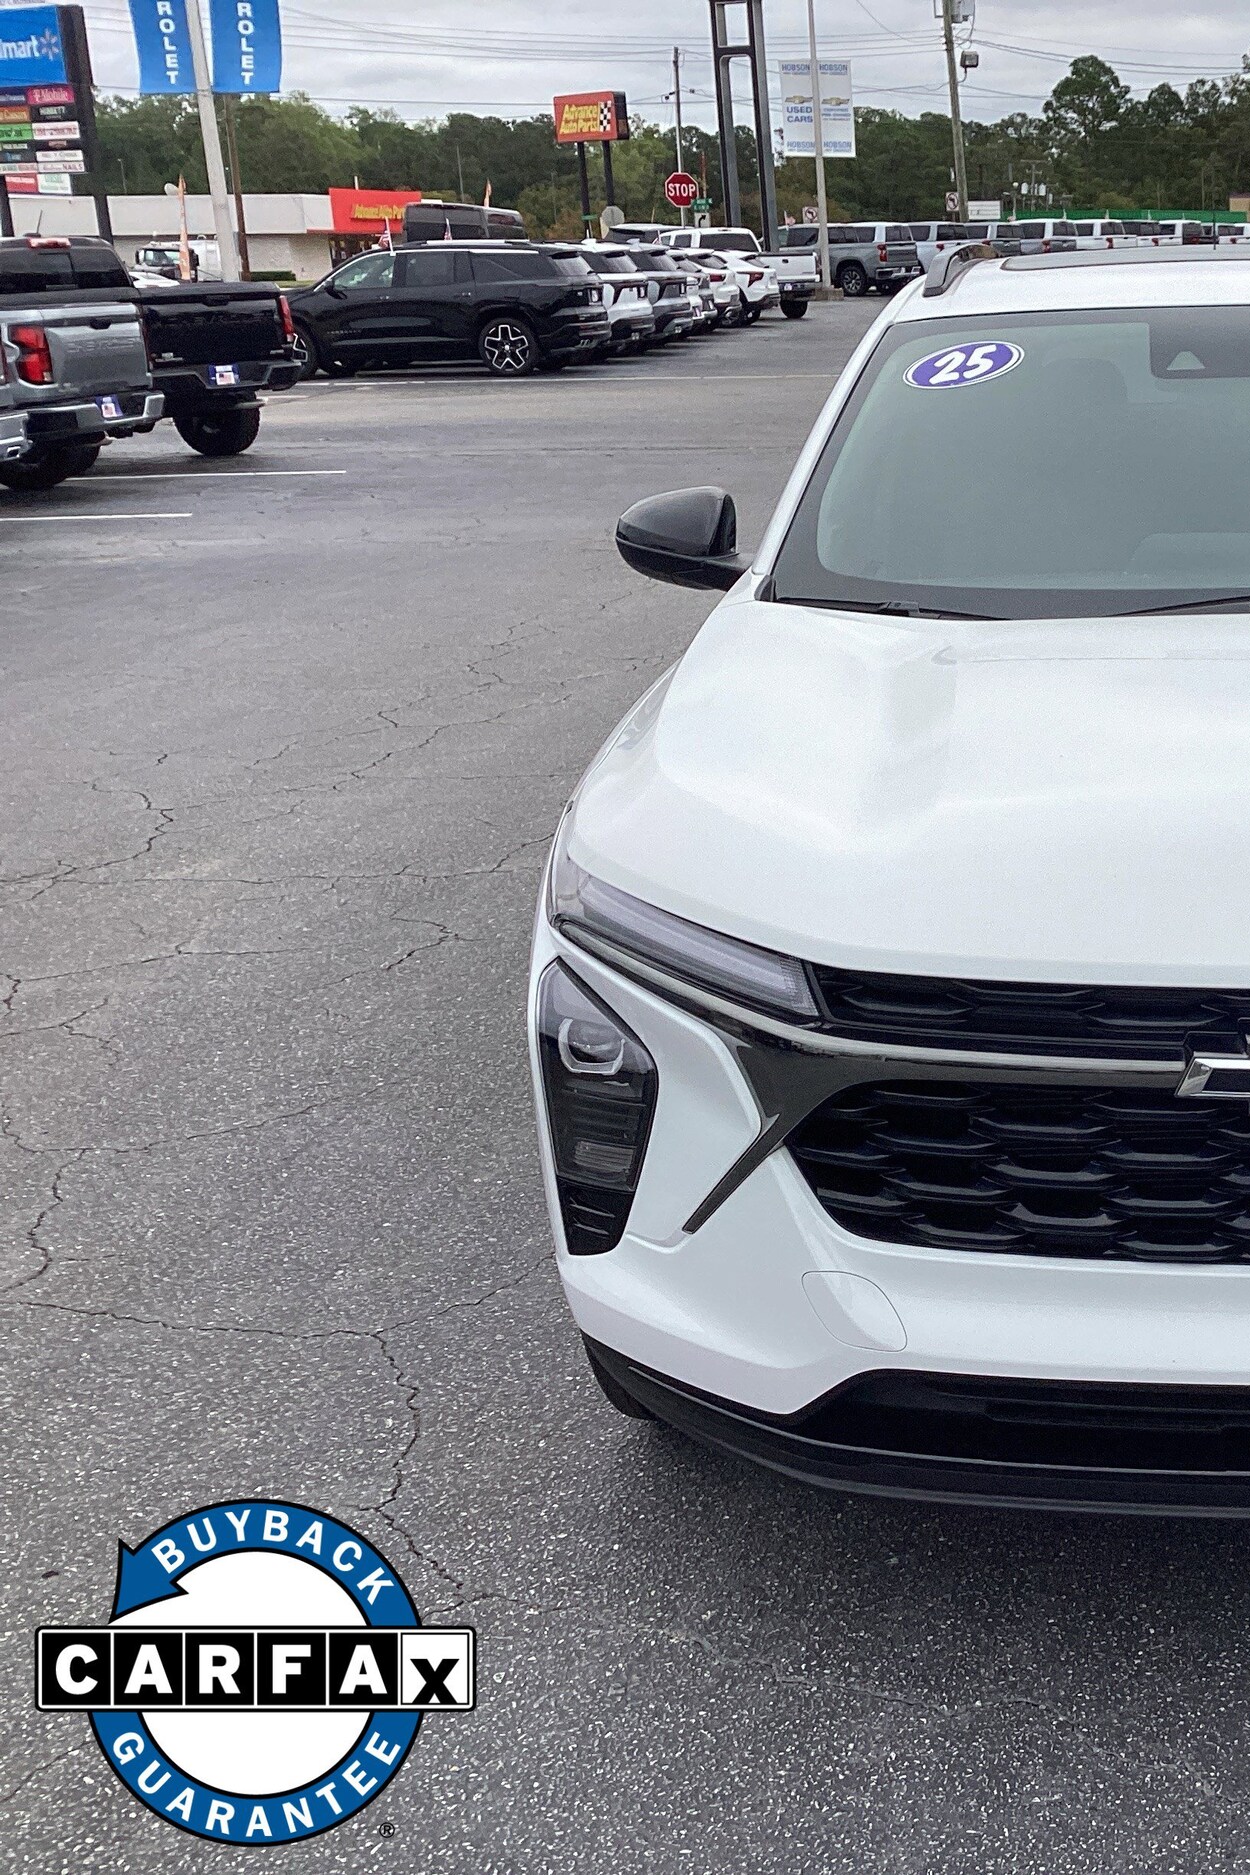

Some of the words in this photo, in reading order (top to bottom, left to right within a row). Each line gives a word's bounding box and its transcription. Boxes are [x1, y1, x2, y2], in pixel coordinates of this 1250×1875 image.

[157, 1, 179, 85] ROLET
[236, 2, 254, 85] ROLET
[781, 64, 811, 72] HOBSON
[819, 64, 848, 72] HOBSON
[564, 104, 598, 119] Advance
[786, 106, 813, 114] USED
[560, 120, 578, 134] Auto
[578, 119, 598, 133] Parts
[823, 140, 852, 148] HOBSON
[668, 183, 696, 197] STOP
[928, 344, 998, 385] 25
